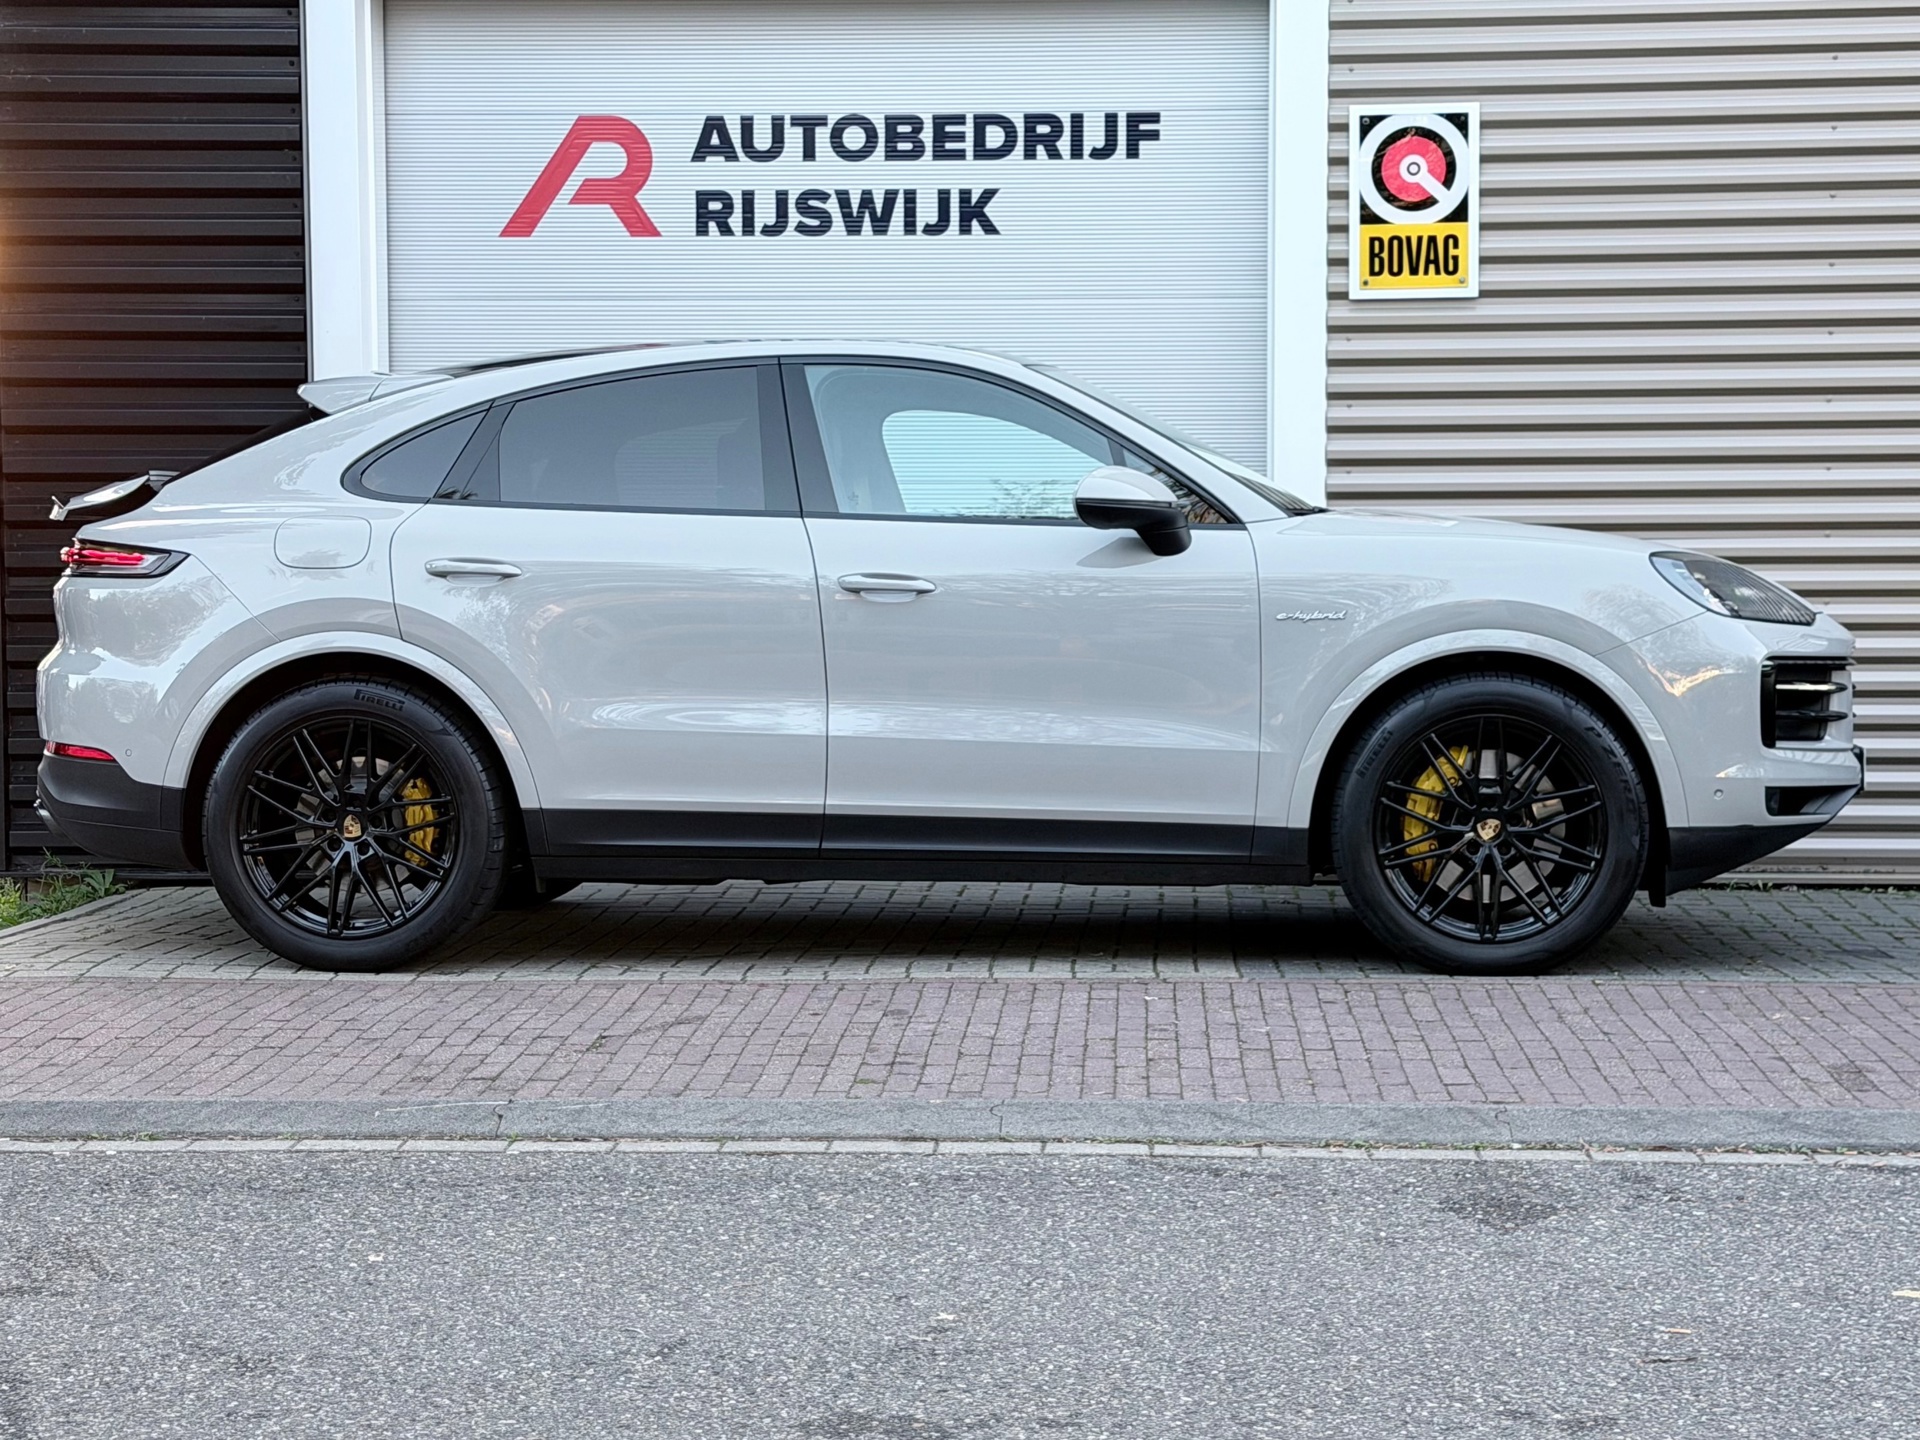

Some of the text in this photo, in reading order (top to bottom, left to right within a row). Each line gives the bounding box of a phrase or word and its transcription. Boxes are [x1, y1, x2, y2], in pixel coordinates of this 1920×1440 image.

[691, 112, 1160, 162] AUTOBEDRIJF
[695, 188, 1001, 236] RIJSWIJK
[1369, 234, 1459, 277] BOVAG
[1275, 610, 1347, 623] e-hybrid
[353, 688, 406, 712] PIRELLI
[1356, 727, 1394, 780] PIRELLI
